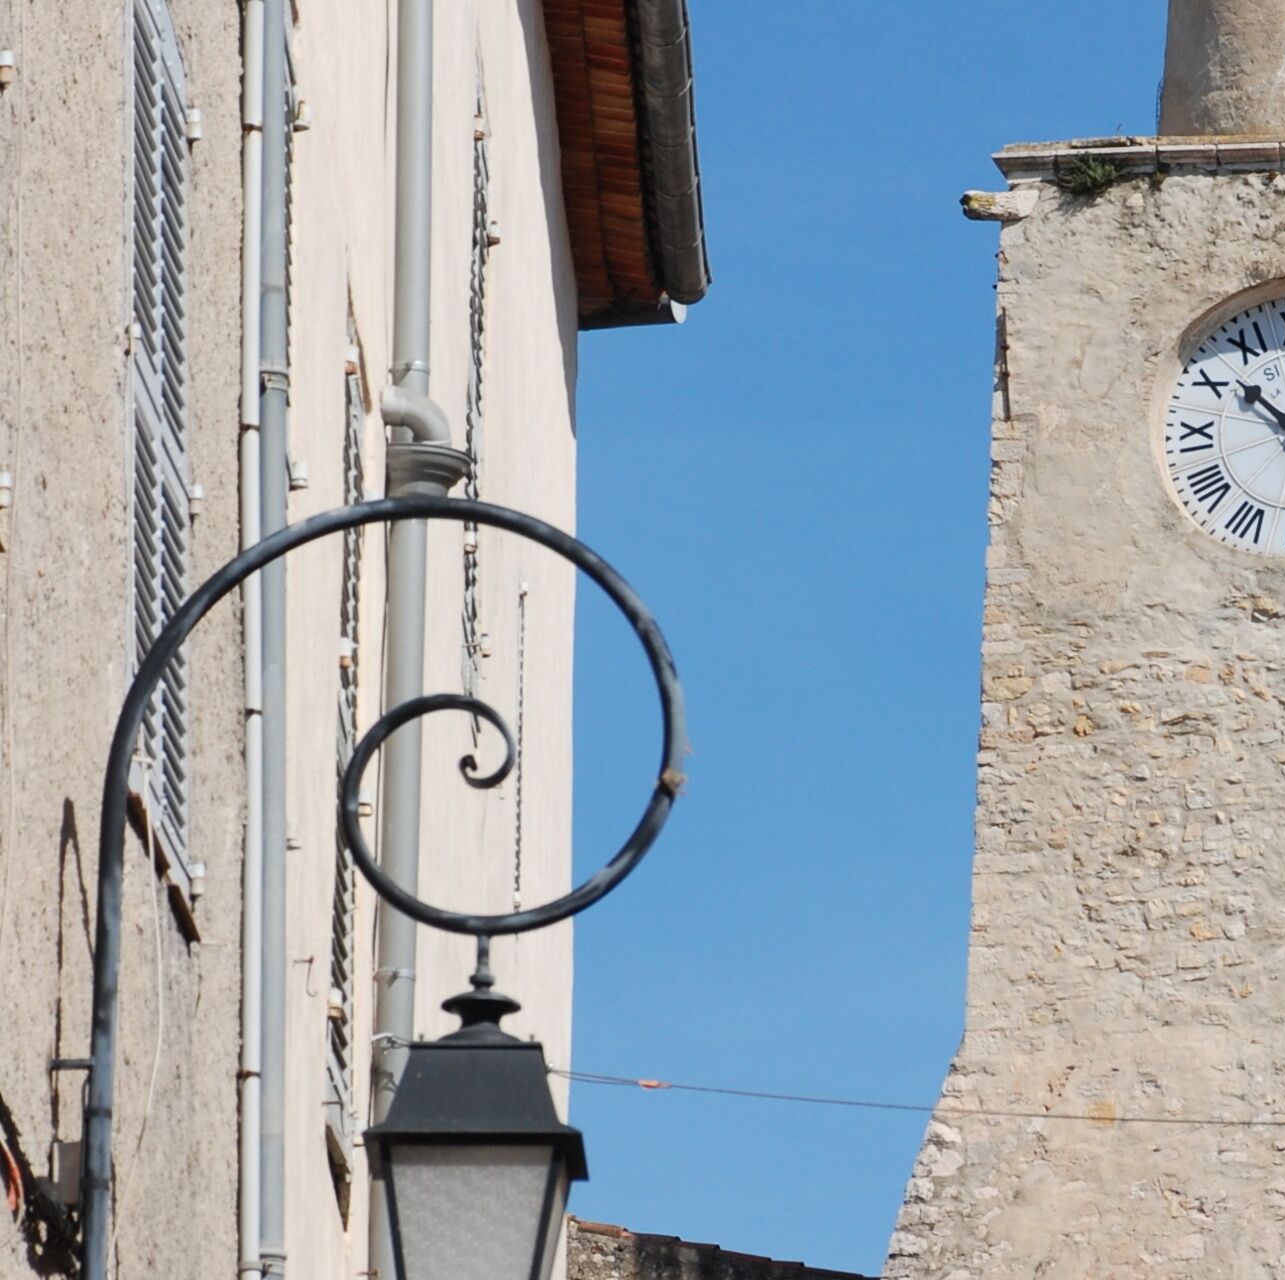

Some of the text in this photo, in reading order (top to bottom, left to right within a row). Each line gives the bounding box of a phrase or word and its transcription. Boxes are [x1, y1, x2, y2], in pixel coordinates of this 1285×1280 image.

[1227, 322, 1267, 366] XI
[1192, 369, 1229, 399] X
[1180, 420, 1214, 453] IX
[1187, 464, 1231, 514] VIII
[1225, 501, 1265, 544] VII
